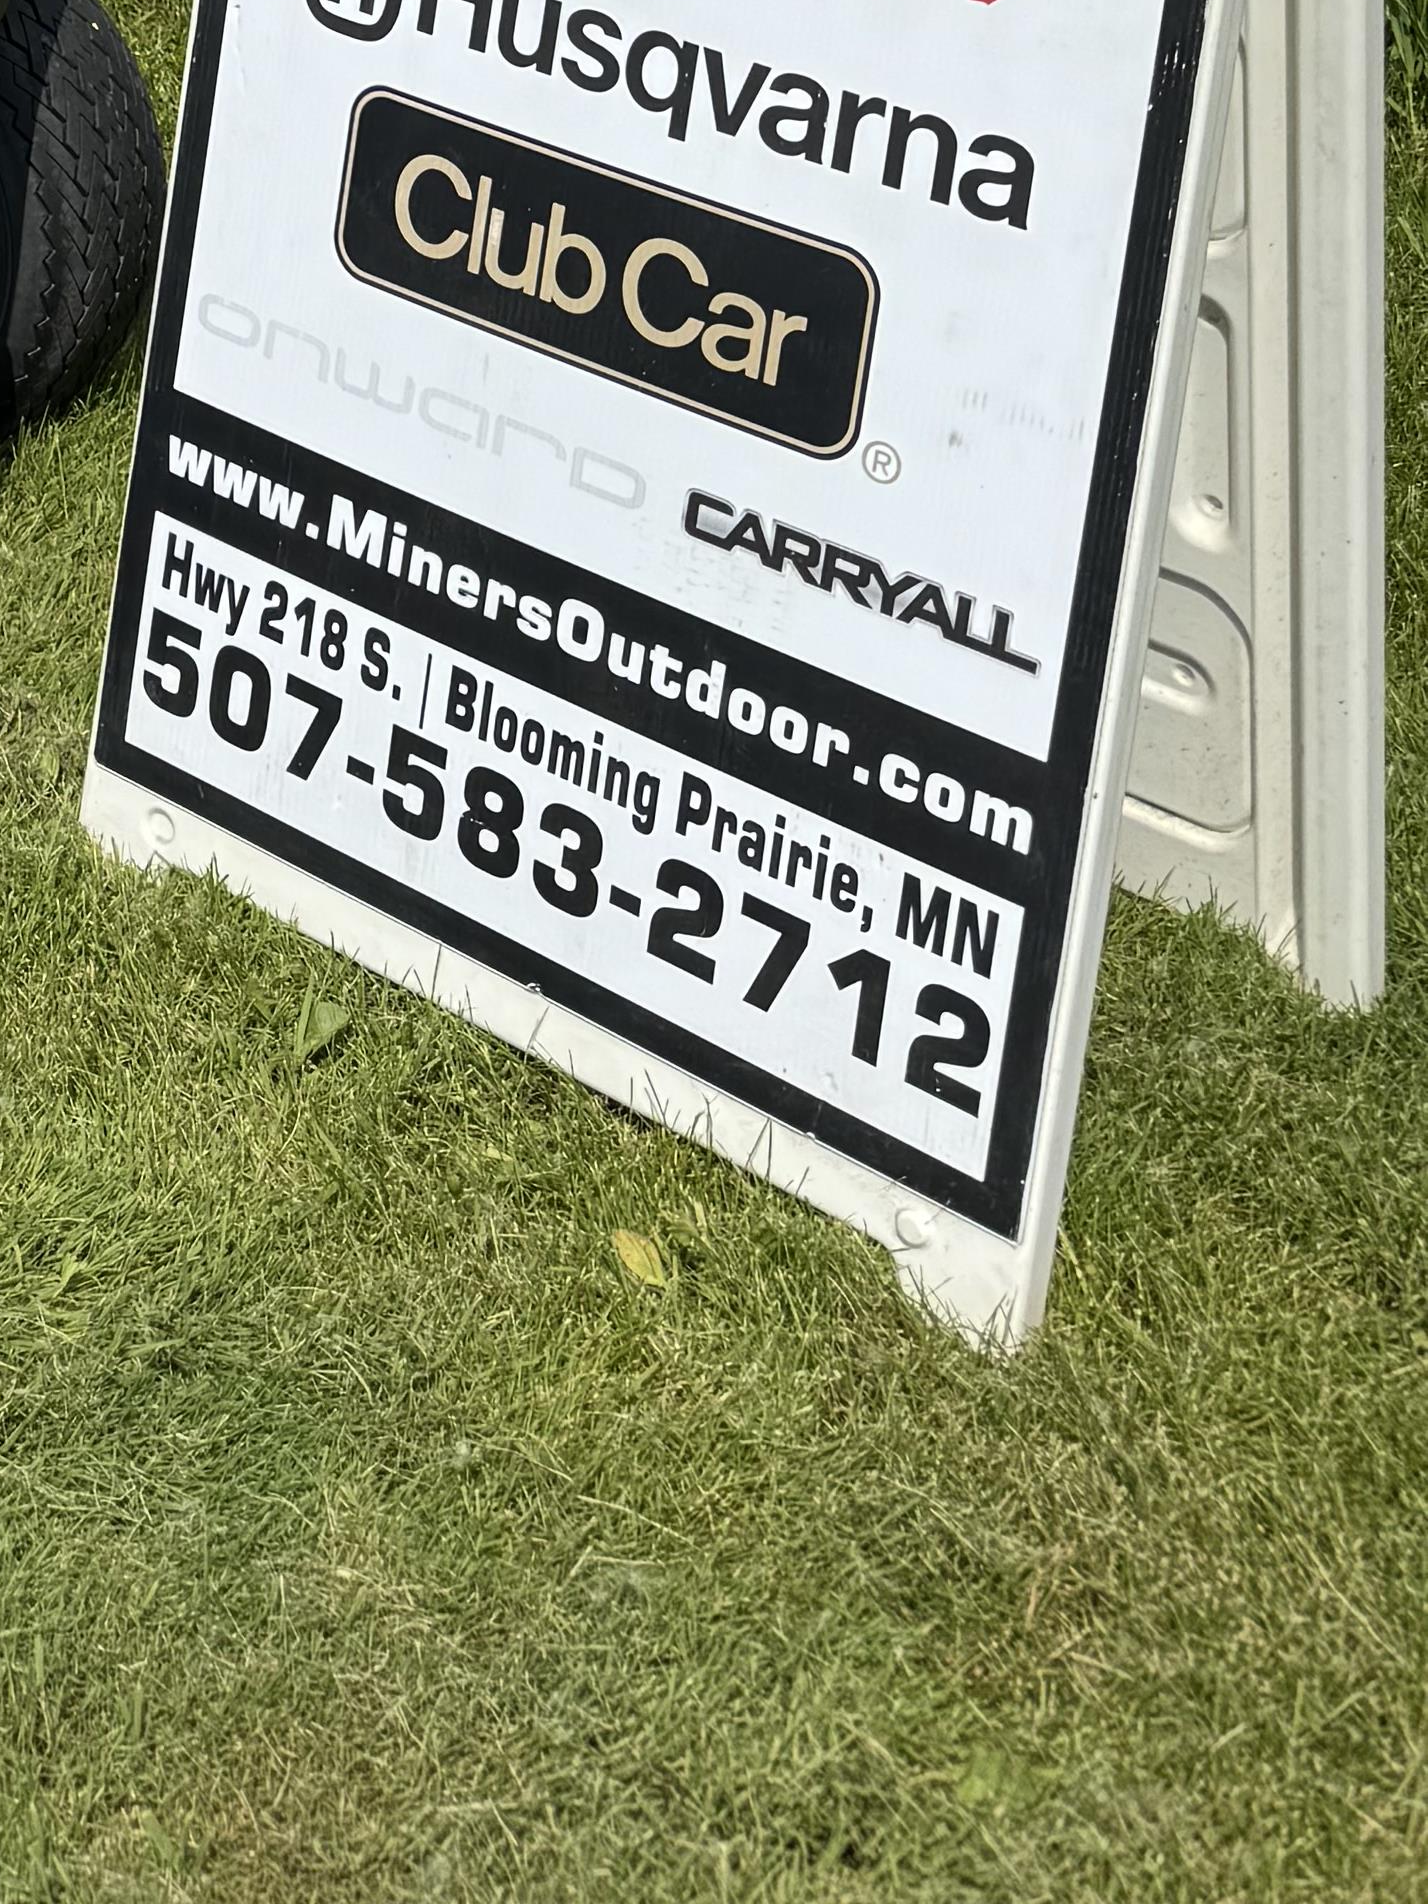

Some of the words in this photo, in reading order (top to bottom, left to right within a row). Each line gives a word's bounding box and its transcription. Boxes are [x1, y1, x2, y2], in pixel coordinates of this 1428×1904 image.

[394, 153, 608, 314] Club
[621, 237, 808, 387] Car
[161, 531, 250, 636] Hwy
[259, 579, 347, 670] 218
[359, 626, 402, 701] S.
[445, 663, 662, 835] Blooming
[675, 770, 874, 934] Prairie,
[895, 871, 1000, 980] MN
[167, 434, 1034, 856] www.MinersOutdoor.com
[682, 487, 1041, 676] CARRYALL
[143, 606, 992, 1118] 507-583-2712
